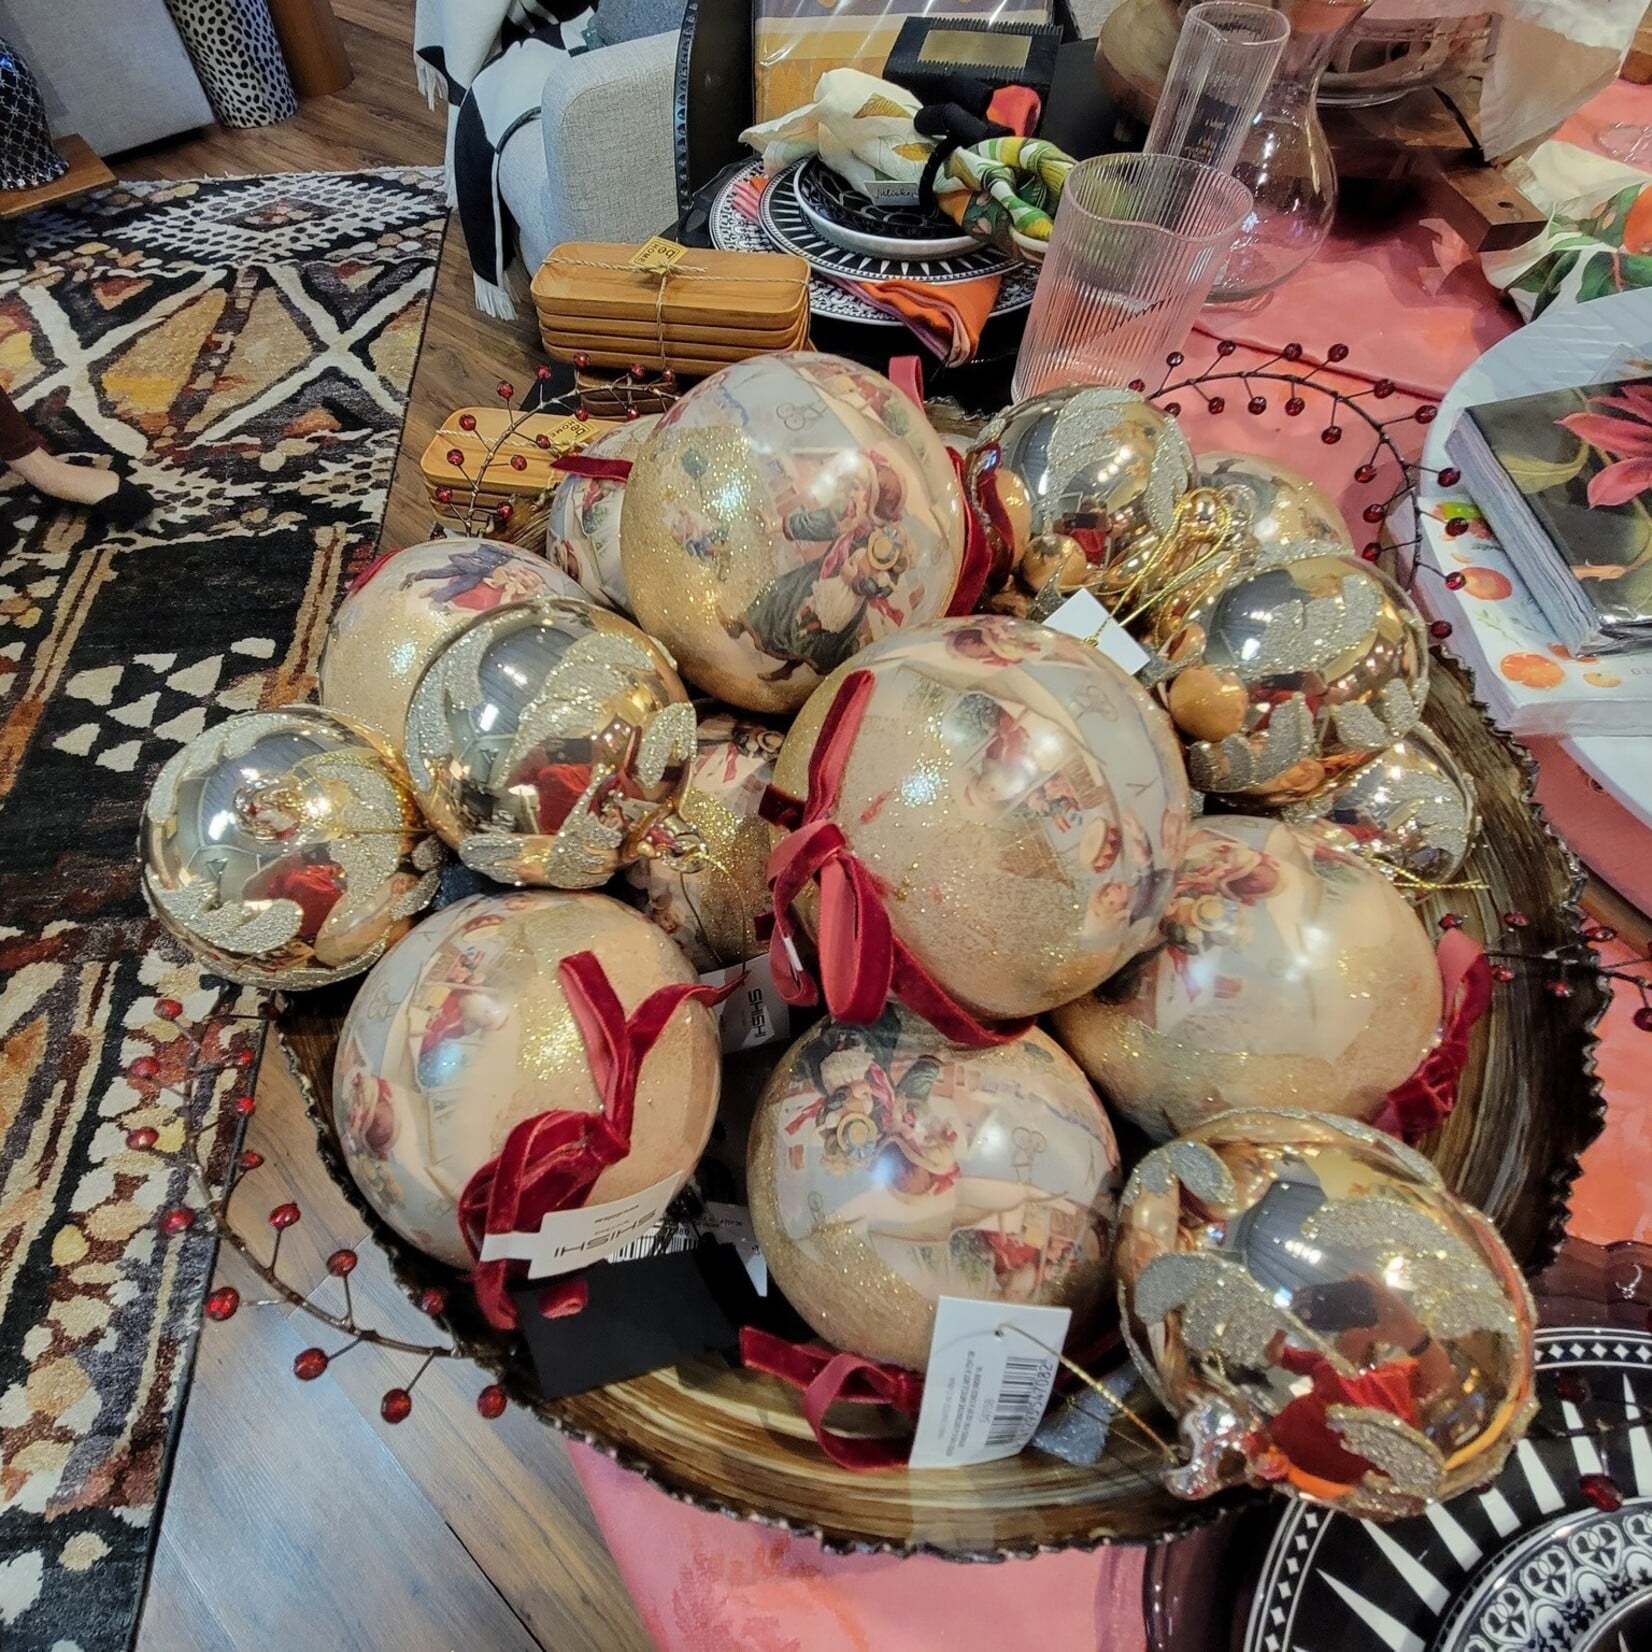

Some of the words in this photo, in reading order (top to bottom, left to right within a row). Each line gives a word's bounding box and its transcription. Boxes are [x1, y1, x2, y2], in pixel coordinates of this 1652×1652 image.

[638, 243, 660, 263] HOME
[657, 246, 676, 260] be
[571, 424, 586, 438] be
[748, 988, 767, 1039] SHISHI
[554, 1208, 658, 1259] SHISHI
